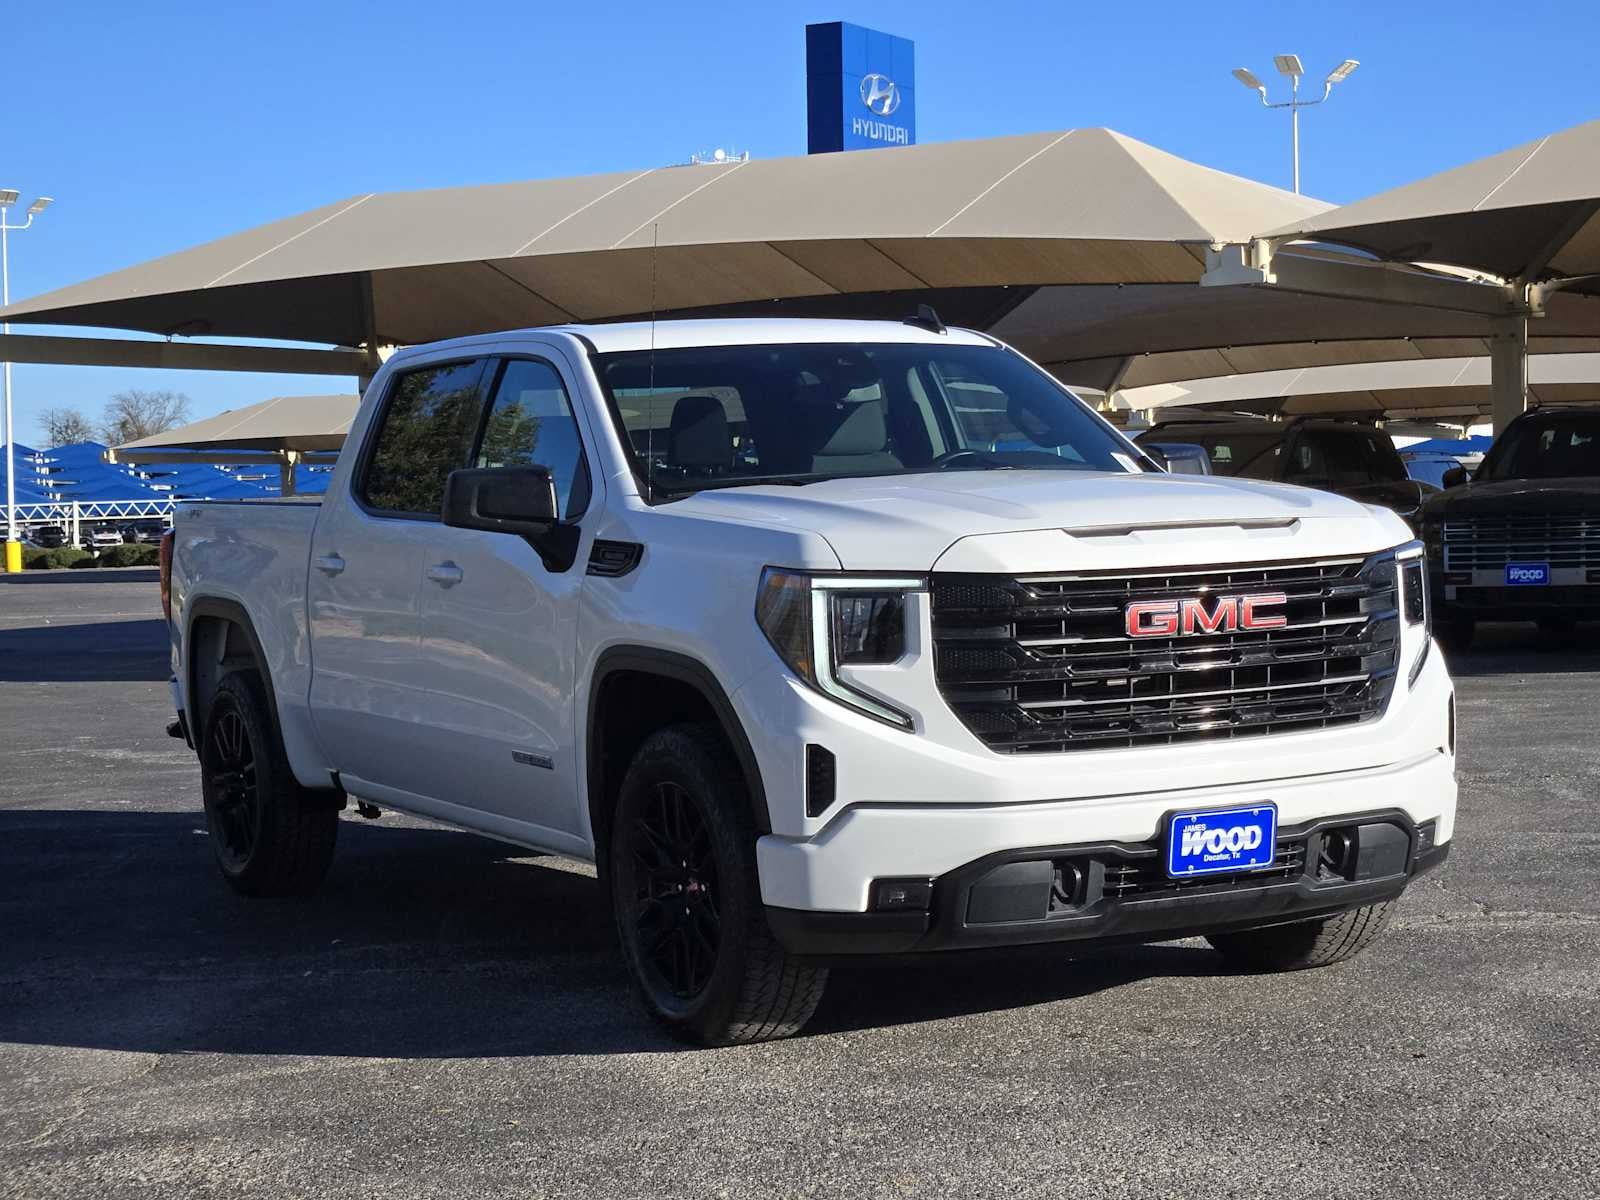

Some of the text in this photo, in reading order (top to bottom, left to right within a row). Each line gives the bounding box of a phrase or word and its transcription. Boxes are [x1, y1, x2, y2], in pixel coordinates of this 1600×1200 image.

[853, 117, 908, 145] HYUNDAI
[1510, 568, 1543, 580] WOOD
[1125, 592, 1287, 638] GMC
[1181, 825, 1262, 857] WOOD
[1182, 823, 1206, 833] JAMES
